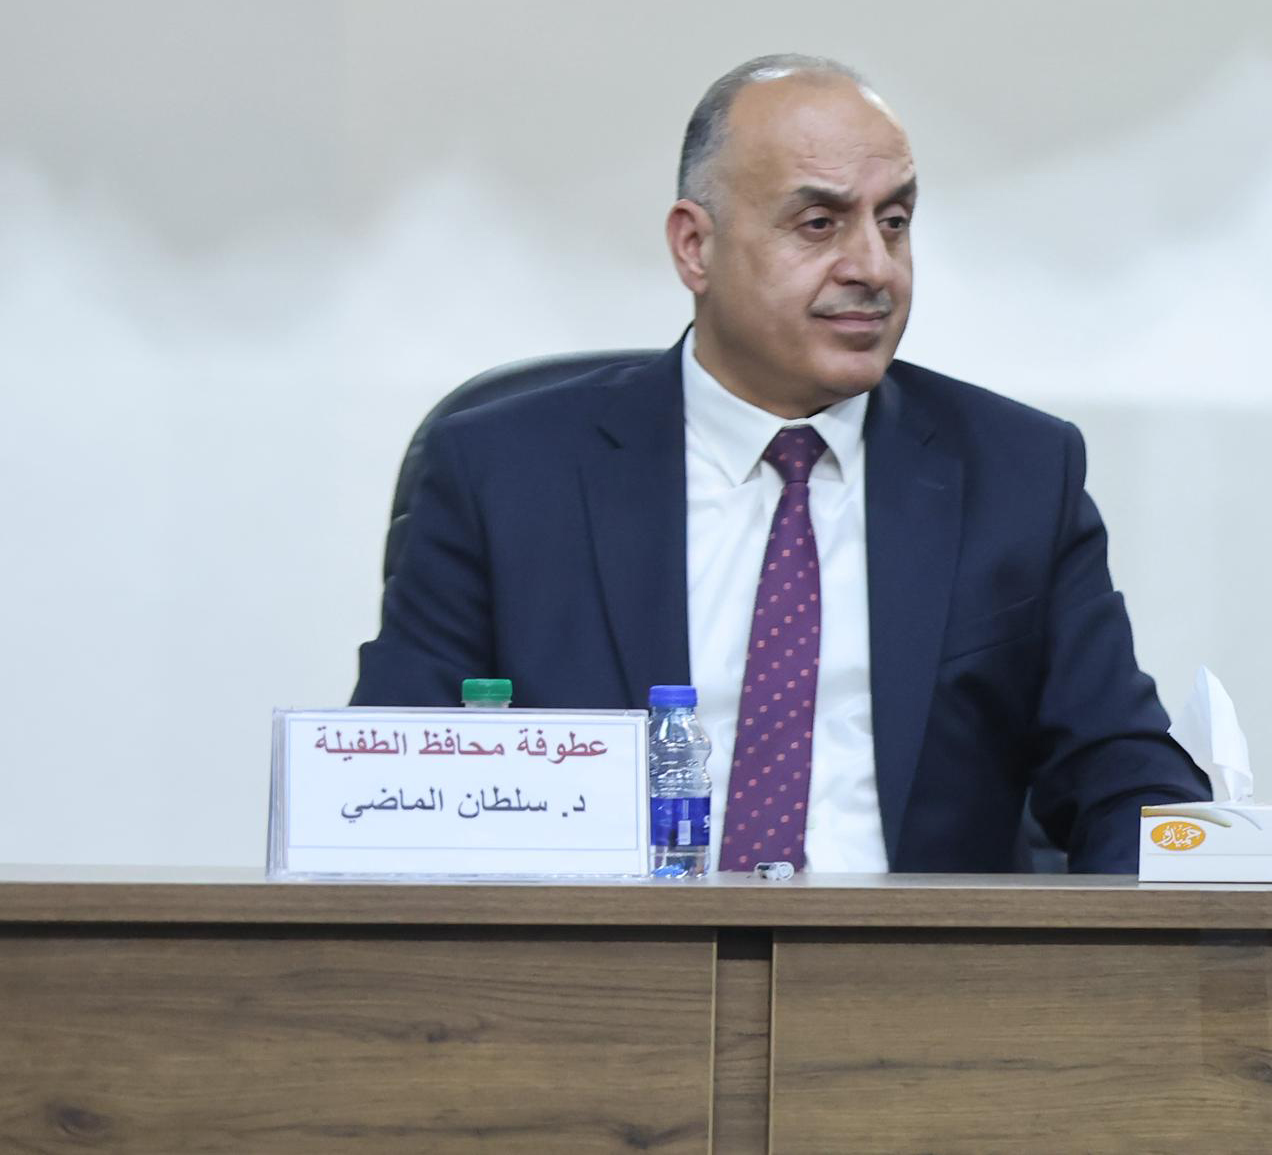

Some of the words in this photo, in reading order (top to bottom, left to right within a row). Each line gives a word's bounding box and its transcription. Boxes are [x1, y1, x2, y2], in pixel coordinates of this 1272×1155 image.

[314, 725, 408, 762] الطفيلة
[418, 727, 506, 757] محافظ
[516, 727, 609, 765] عطوفة
[340, 786, 444, 824] الماضي
[457, 785, 548, 819] سلطان
